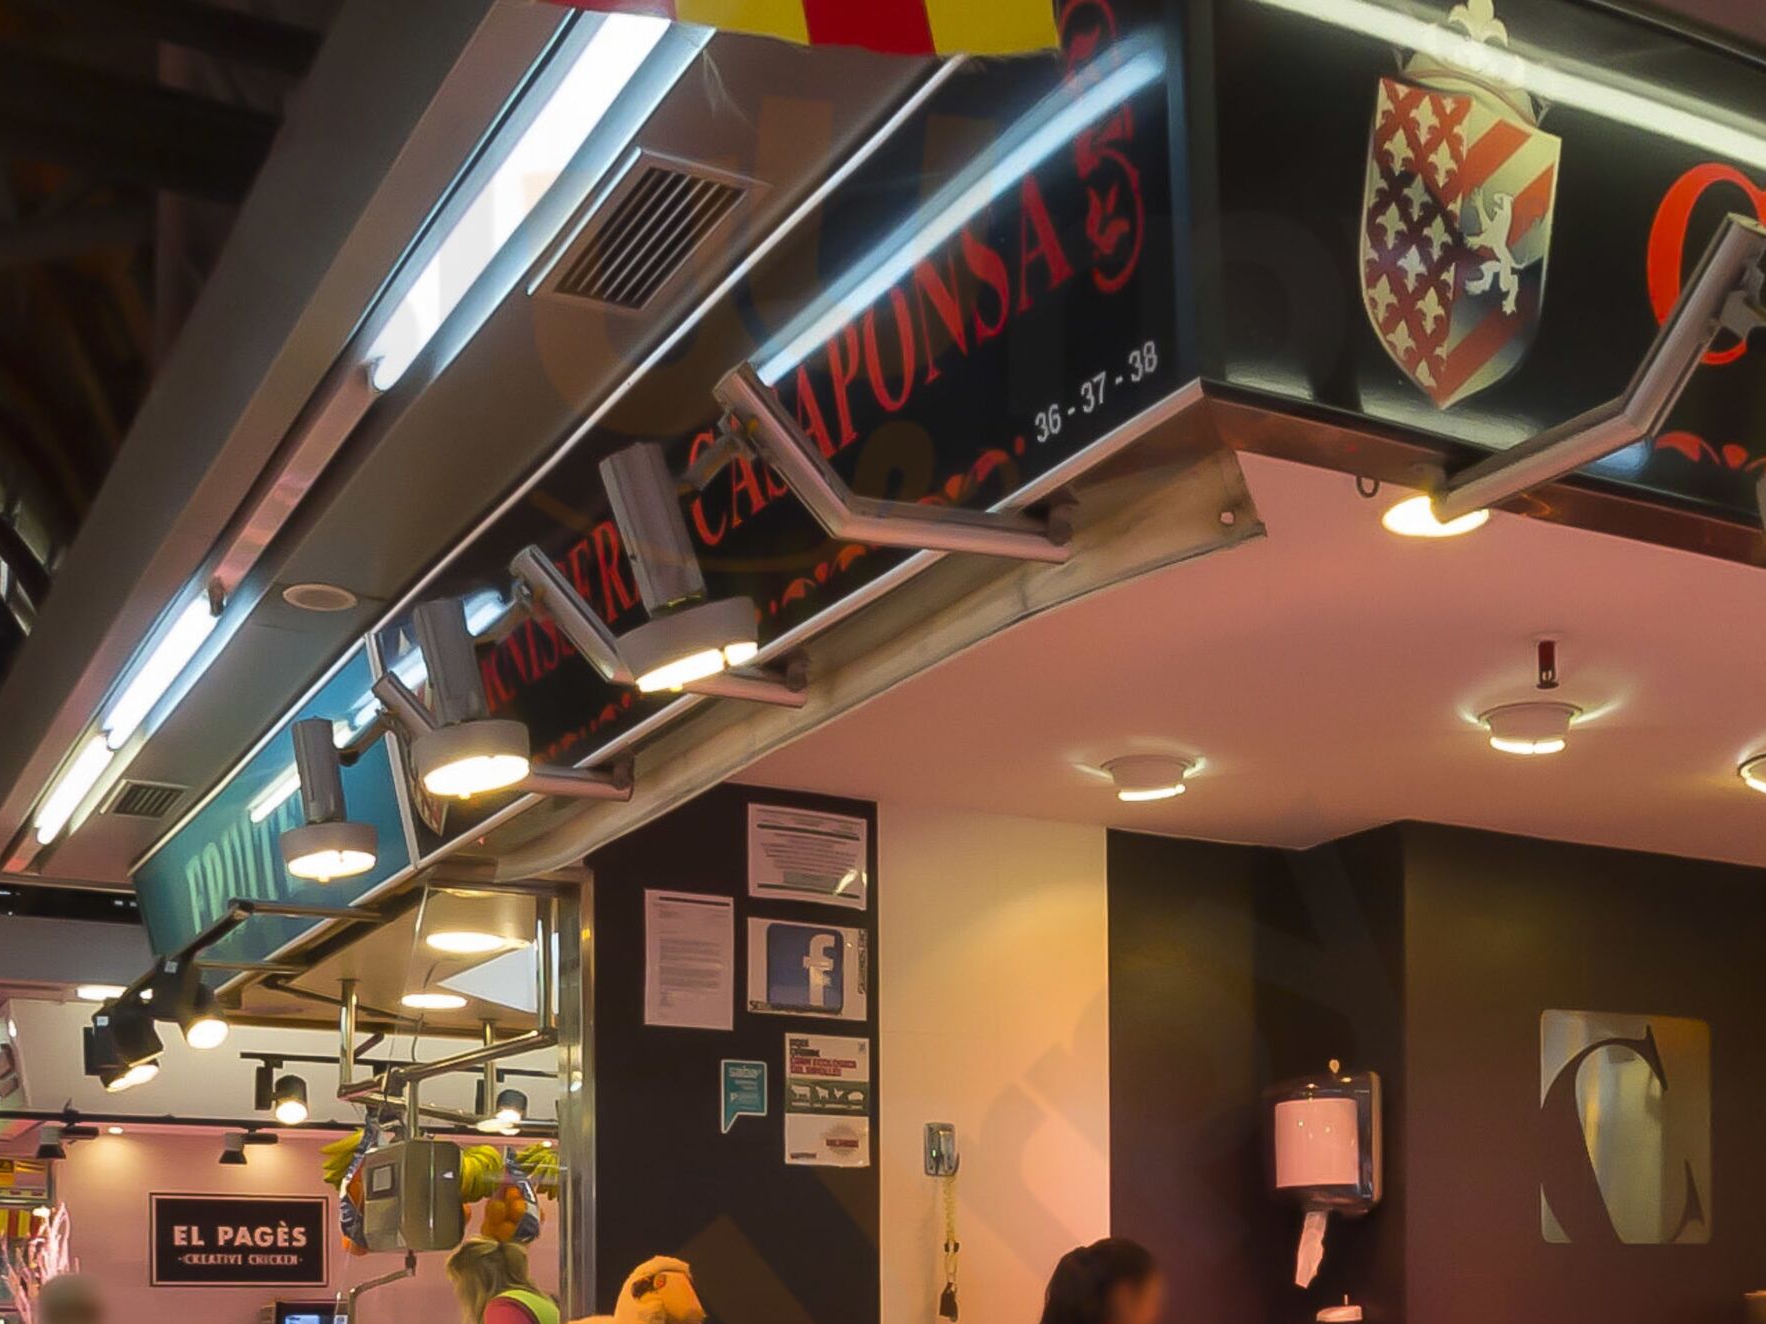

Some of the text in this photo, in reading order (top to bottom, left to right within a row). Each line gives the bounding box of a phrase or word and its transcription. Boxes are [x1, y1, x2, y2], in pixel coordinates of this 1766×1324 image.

[1035, 403, 1064, 444] 36
[1080, 371, 1107, 413] 37
[1128, 340, 1159, 383] 38
[173, 1220, 308, 1248] EL PAGÈS
[248, 1253, 299, 1266] CHICKEN
